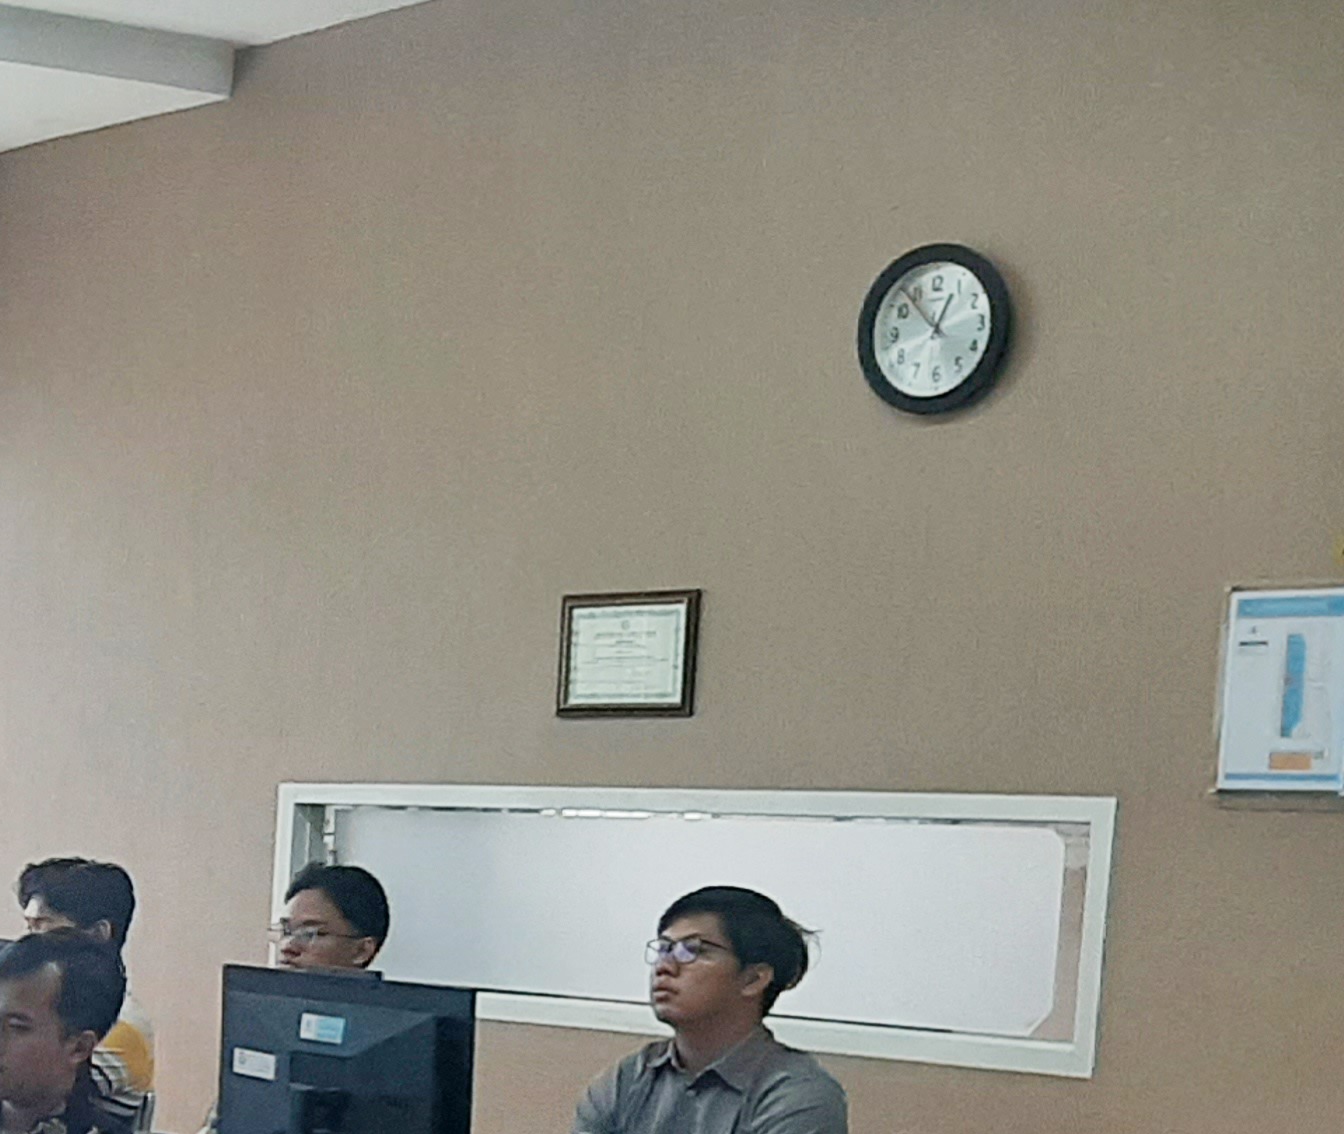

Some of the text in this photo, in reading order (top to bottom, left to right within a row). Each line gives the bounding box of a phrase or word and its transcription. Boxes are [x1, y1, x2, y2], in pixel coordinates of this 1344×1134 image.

[932, 275, 944, 292] 12
[957, 280, 962, 295] 1
[970, 294, 978, 309] 2
[897, 303, 909, 319] 10
[976, 314, 985, 331] 3
[890, 326, 899, 343] 9
[969, 339, 978, 351] 4
[897, 349, 905, 365] 8
[954, 356, 963, 373] 5
[912, 362, 921, 379] 7
[932, 366, 941, 382] 6
